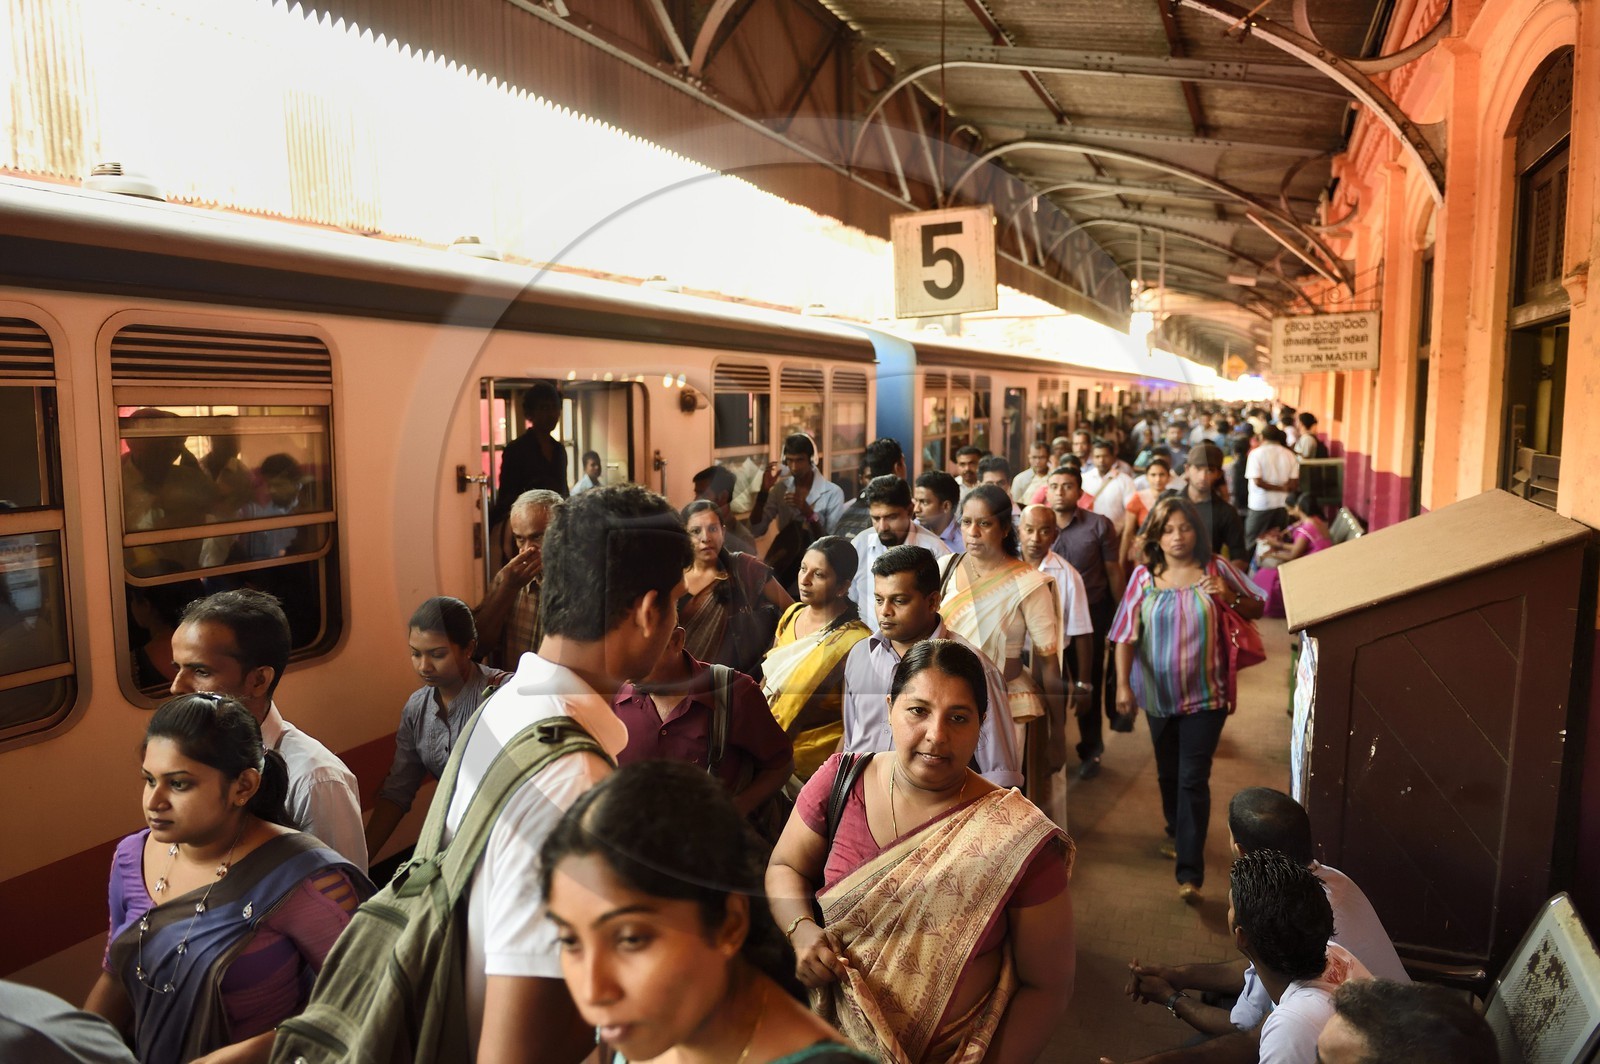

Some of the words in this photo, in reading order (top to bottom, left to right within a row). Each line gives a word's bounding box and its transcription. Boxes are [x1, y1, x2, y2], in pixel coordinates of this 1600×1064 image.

[920, 221, 965, 300] 5
[1282, 353, 1323, 364] STATION
[1325, 351, 1368, 362] MASTER
